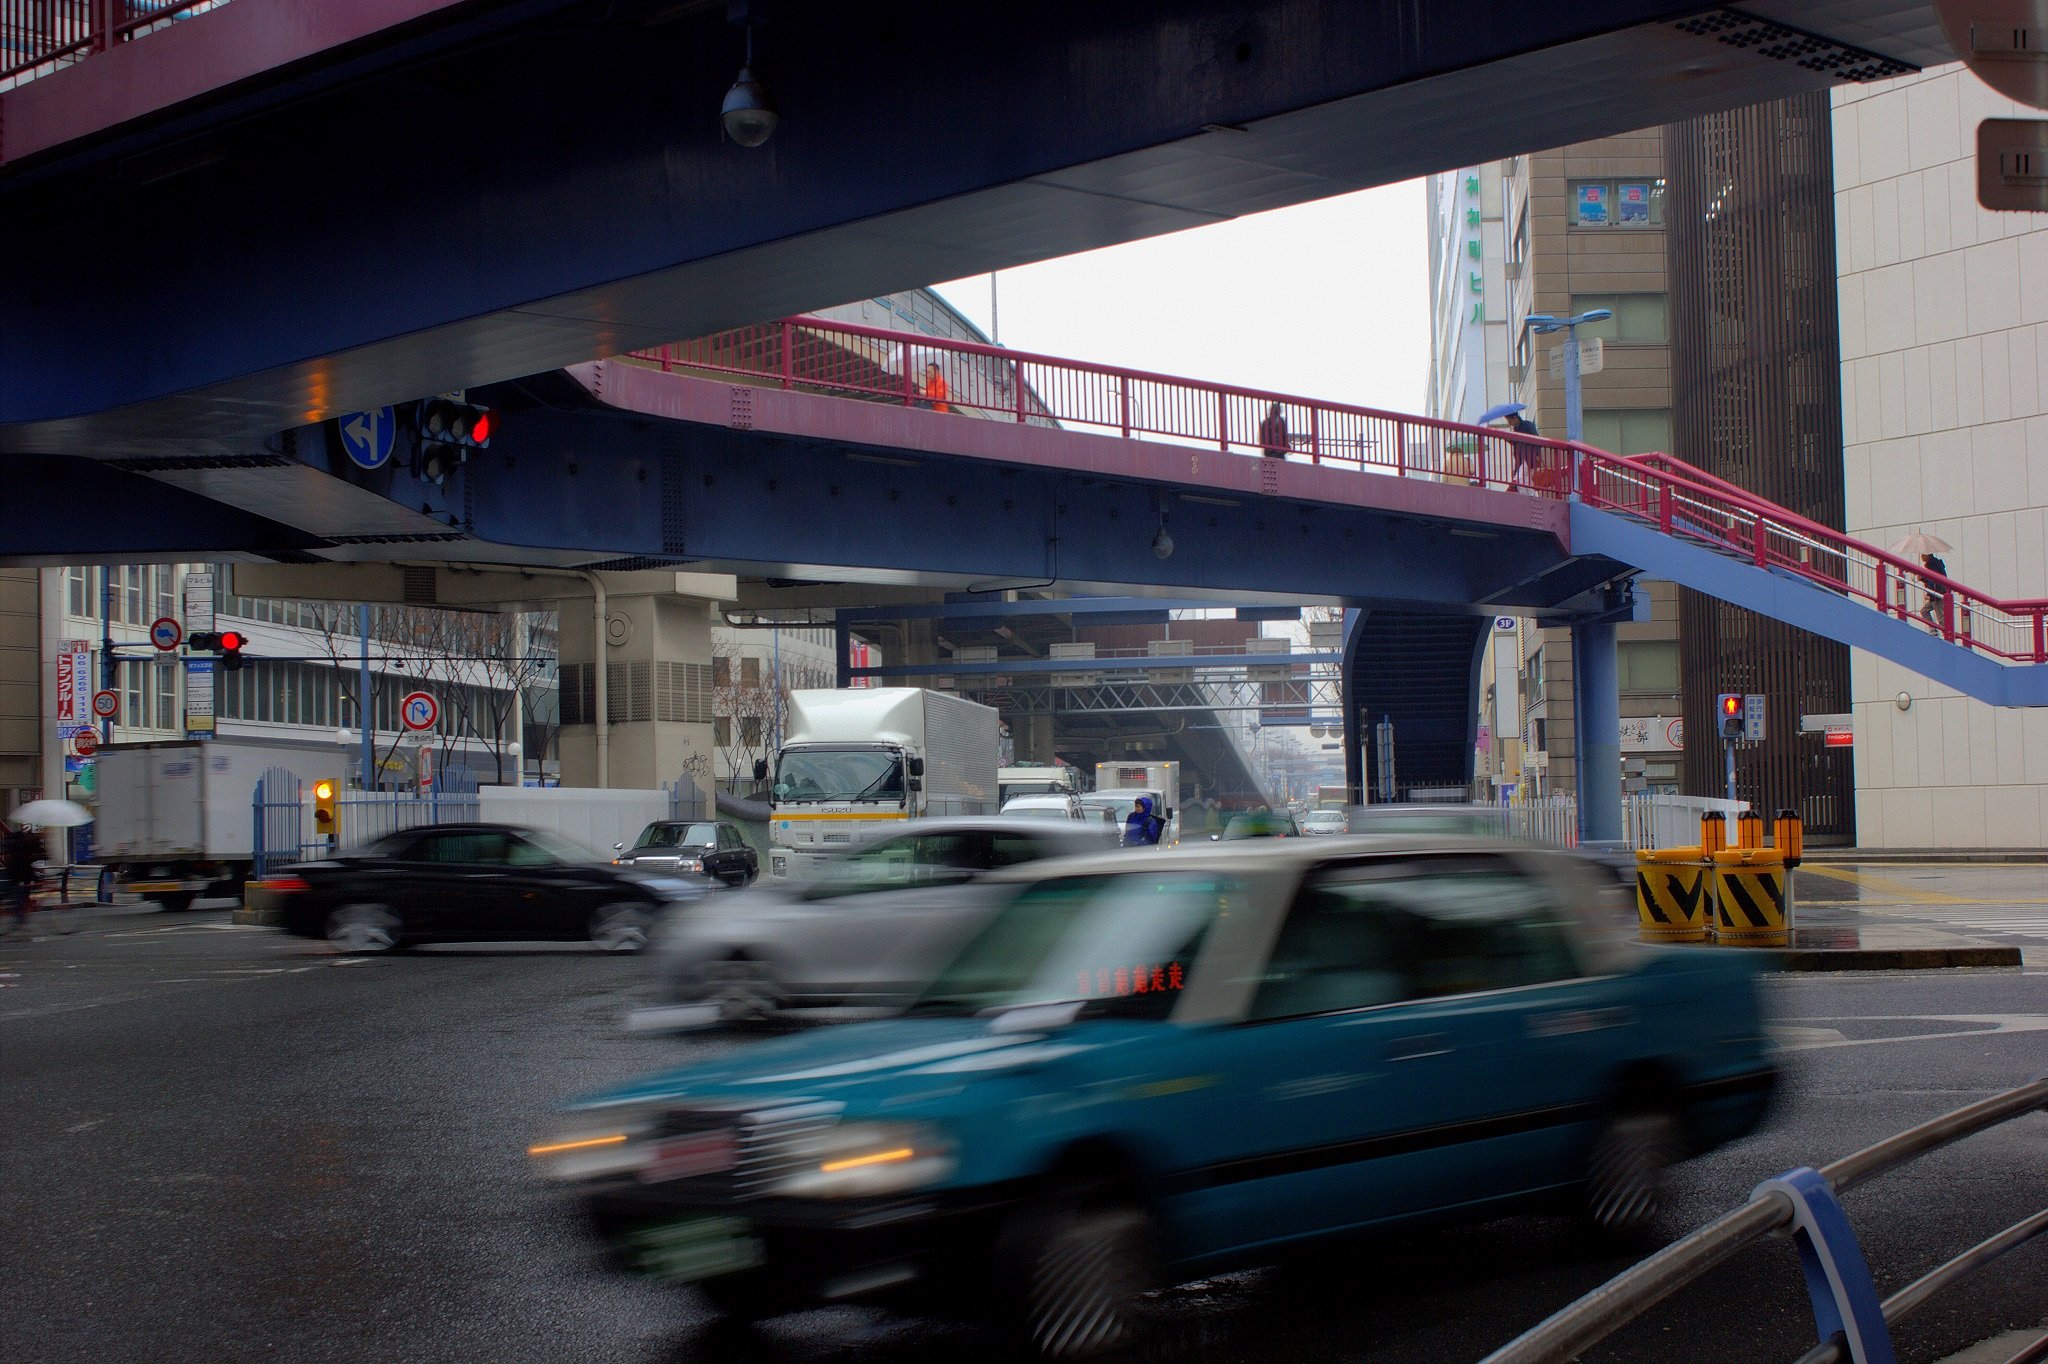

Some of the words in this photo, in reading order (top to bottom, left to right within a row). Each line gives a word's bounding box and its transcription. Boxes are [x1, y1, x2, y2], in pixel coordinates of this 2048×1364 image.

[1499, 619, 1512, 628] 3F
[58, 655, 72, 720] トランクルーム
[97, 698, 113, 710] 50
